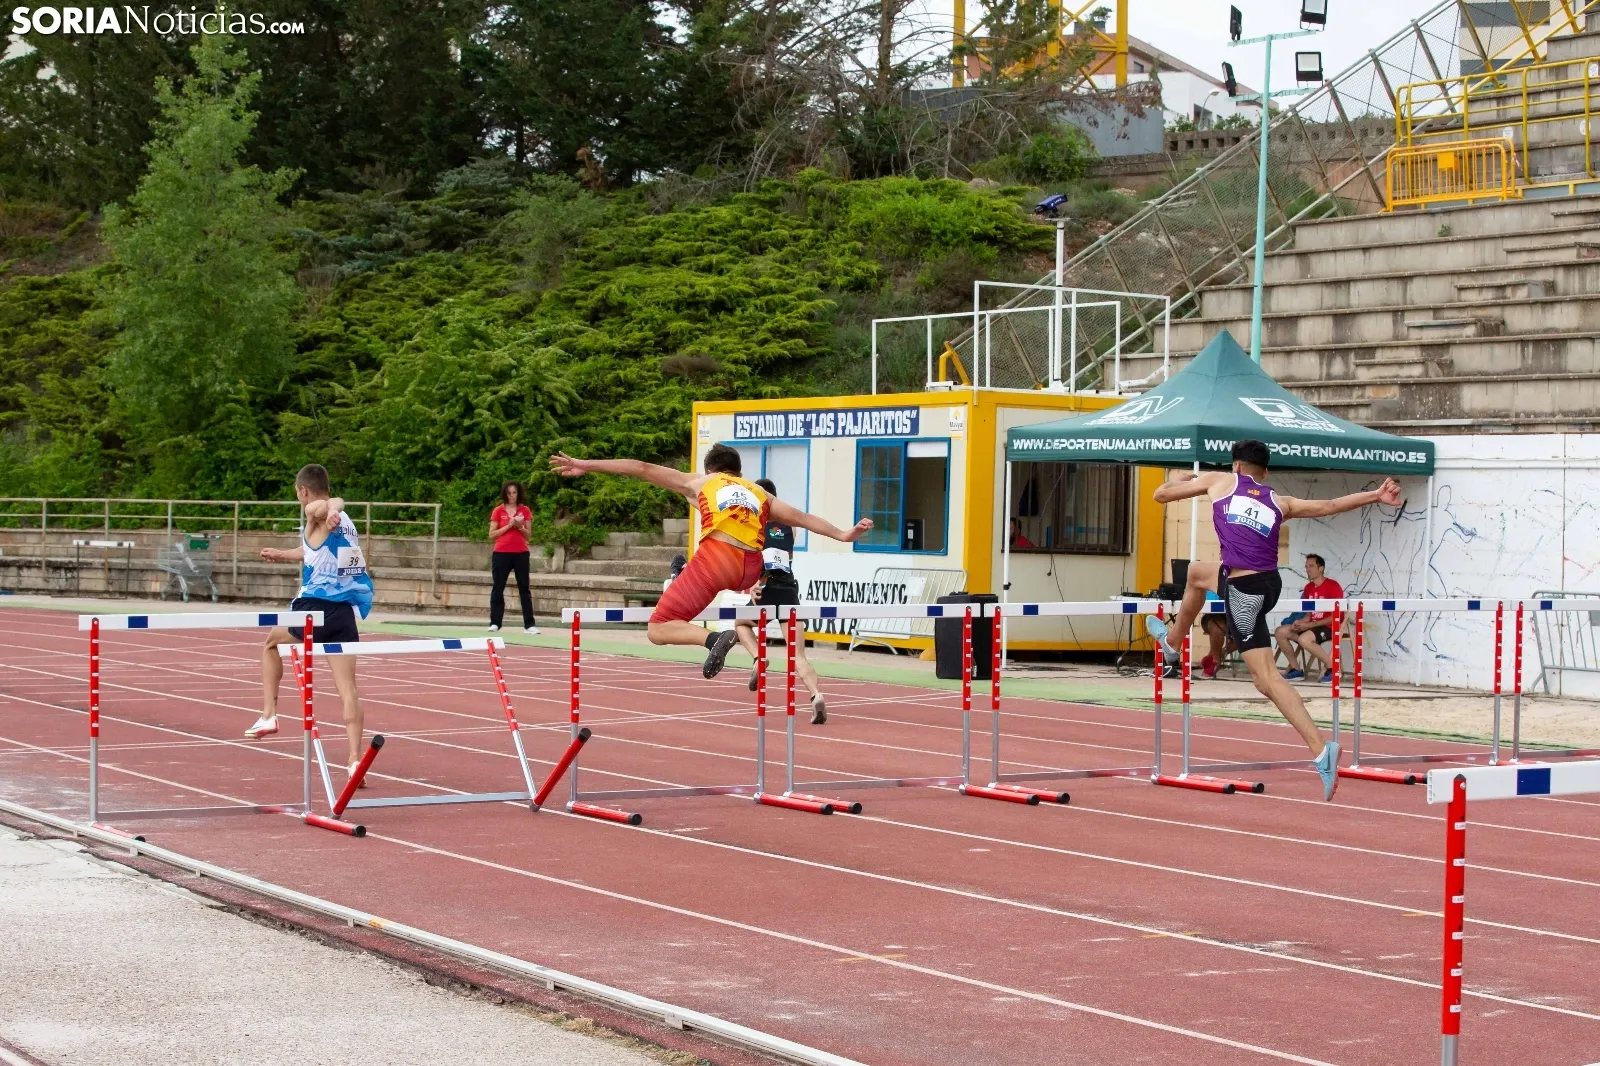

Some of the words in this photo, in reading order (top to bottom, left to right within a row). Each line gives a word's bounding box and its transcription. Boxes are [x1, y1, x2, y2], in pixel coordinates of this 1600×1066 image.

[736, 415, 784, 438] ESTADIO
[787, 414, 803, 437] DE
[805, 412, 835, 436] "LOS
[837, 410, 917, 435] PAJARITOS"
[1013, 438, 1192, 450] WWW.DEPORTENUMANTINO.ES
[1203, 439, 1427, 464] WWPORTENUMANTINO.ES
[732, 491, 748, 501] 45
[1244, 507, 1260, 520] 41
[349, 557, 360, 567] 39
